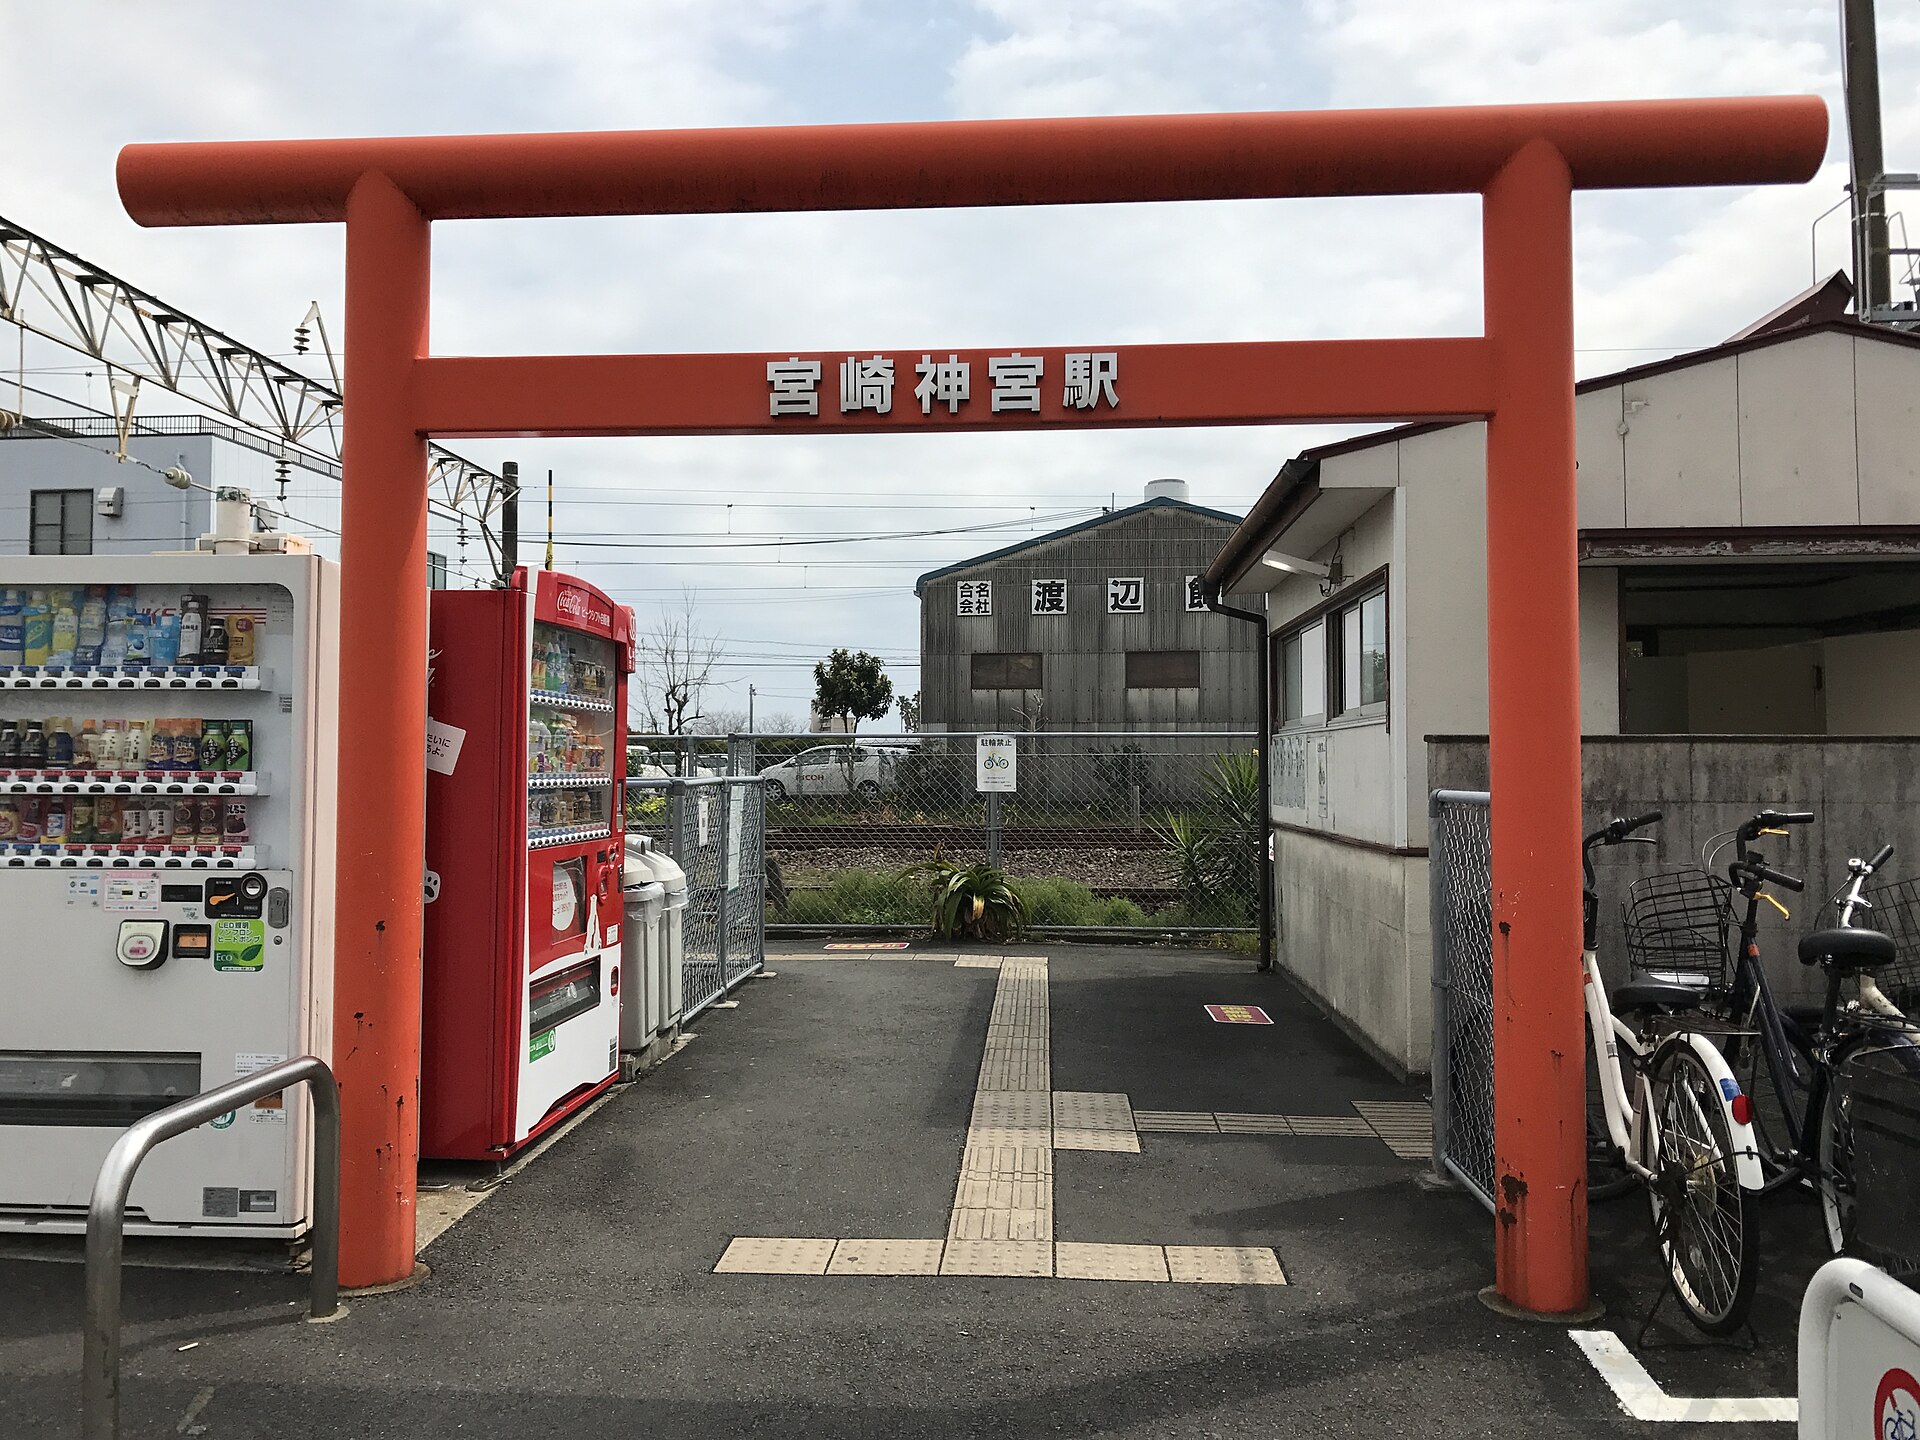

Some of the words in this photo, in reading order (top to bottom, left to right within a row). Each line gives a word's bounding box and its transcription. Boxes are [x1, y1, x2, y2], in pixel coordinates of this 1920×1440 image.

[766, 352, 1120, 416] 宮崎神宮駅
[959, 582, 991, 598] 合名
[959, 598, 991, 614] 会社
[980, 739, 1012, 747] 駐輪禁止
